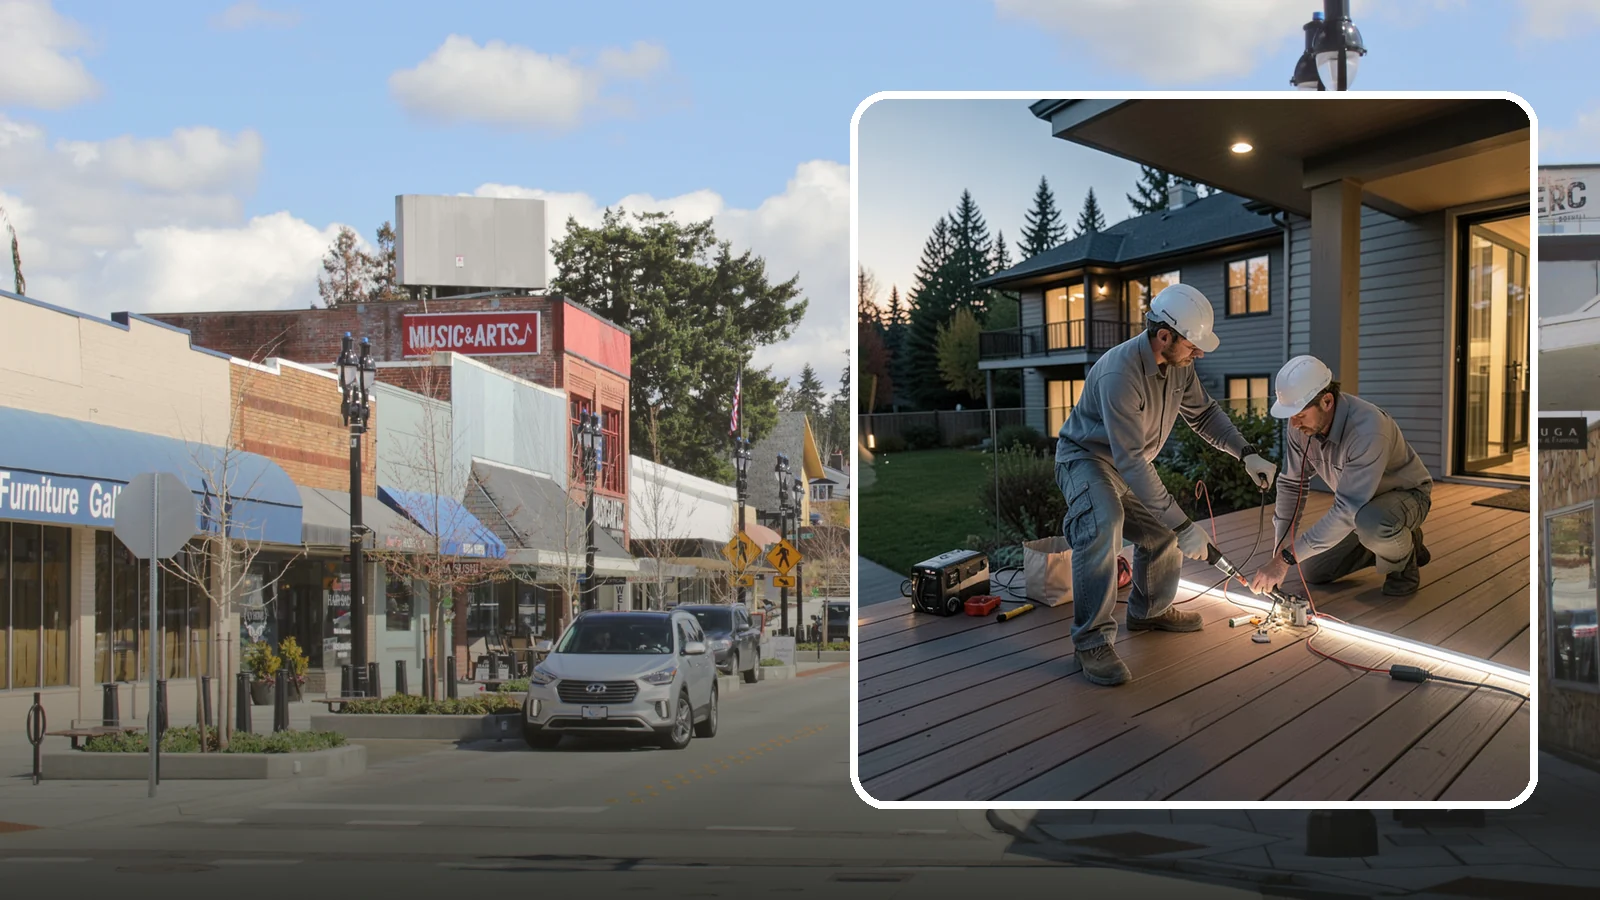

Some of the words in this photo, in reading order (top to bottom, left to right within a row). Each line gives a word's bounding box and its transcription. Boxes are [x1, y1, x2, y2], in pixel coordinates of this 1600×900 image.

[0, 471, 79, 515] Furniture
[89, 483, 122, 519] Gal
[453, 563, 479, 574] SUSHI
